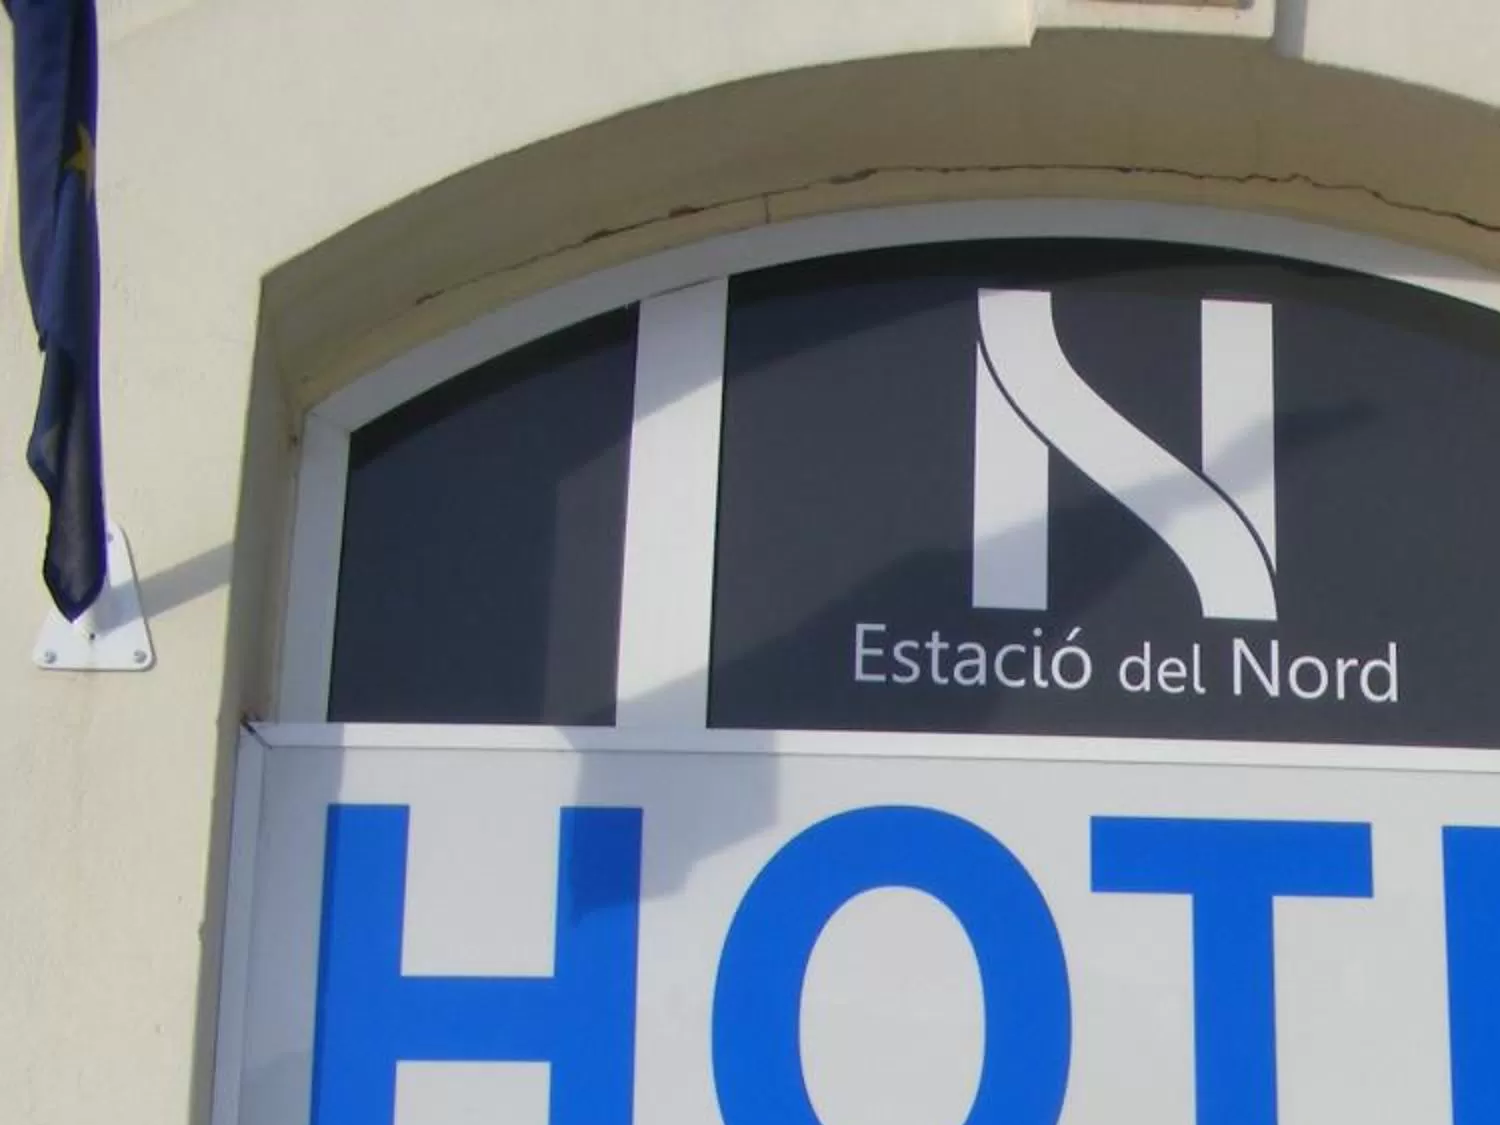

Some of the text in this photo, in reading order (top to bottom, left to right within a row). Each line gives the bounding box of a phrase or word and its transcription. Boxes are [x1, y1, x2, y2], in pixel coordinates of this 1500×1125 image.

[853, 623, 1399, 703] Estació del Nord
